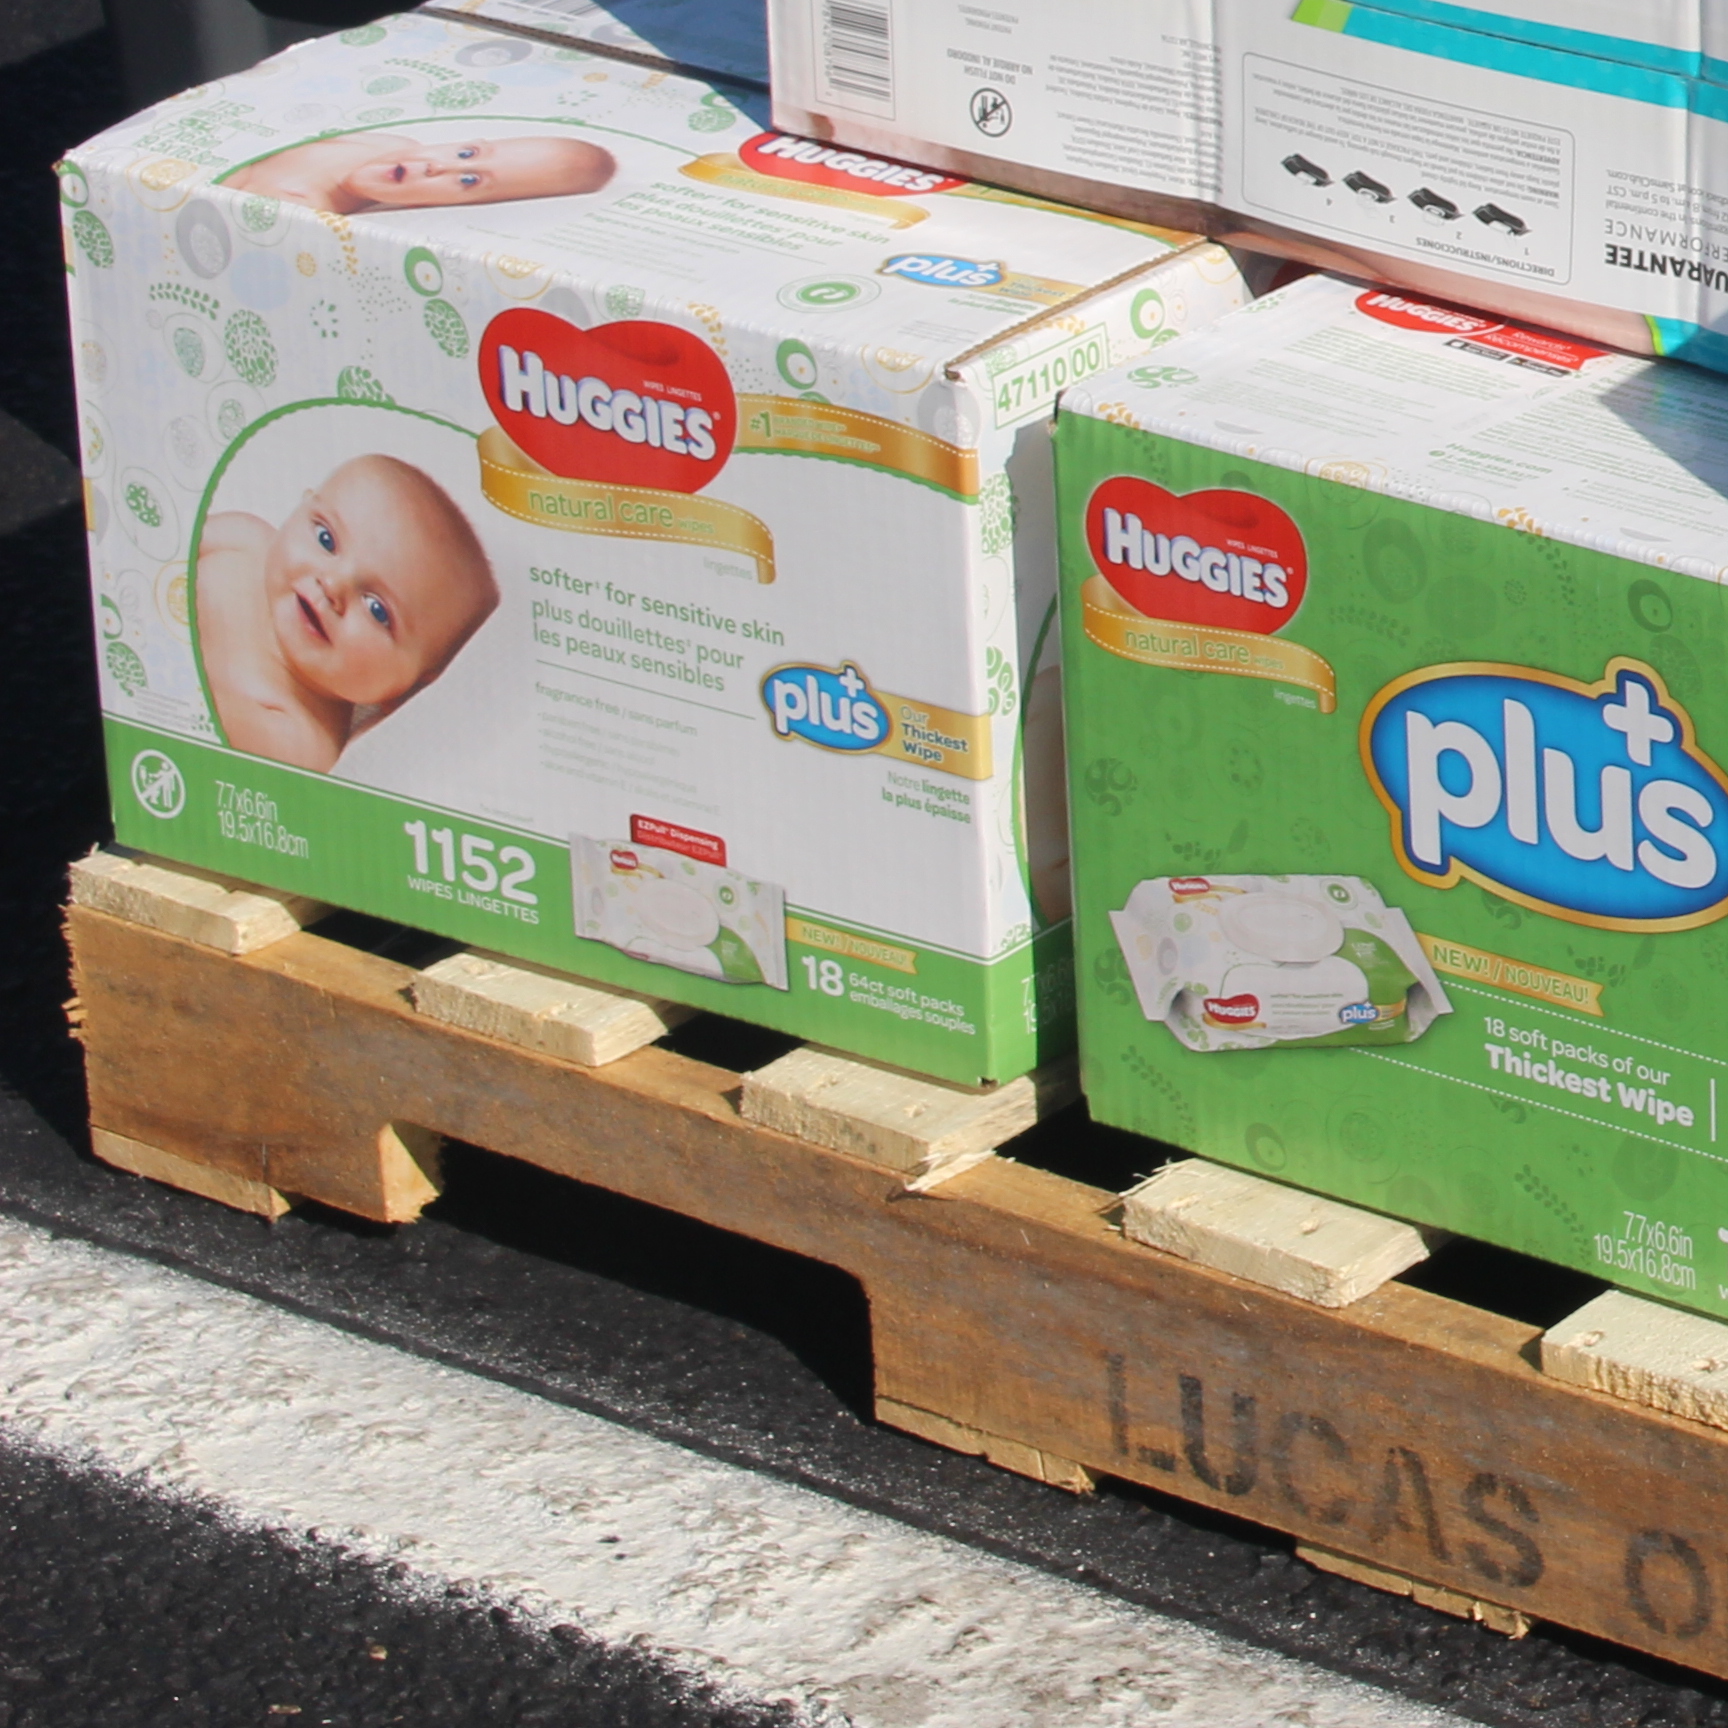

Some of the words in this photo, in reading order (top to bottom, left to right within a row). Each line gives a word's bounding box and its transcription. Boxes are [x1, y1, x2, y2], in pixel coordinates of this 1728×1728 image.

[497, 344, 717, 463] HUGGIES
[527, 487, 615, 523] natural
[619, 499, 674, 530] care
[1102, 508, 1292, 611] HUGGIES
[1124, 625, 1198, 660] natural
[1203, 637, 1249, 666] care
[769, 671, 881, 744] plus
[899, 723, 968, 753] Thickest
[1403, 697, 1719, 890] plus
[404, 817, 538, 906] 1152
[1483, 1042, 1612, 1105] Thickest
[1616, 1082, 1696, 1129] Wipe
[1104, 1350, 1546, 1588] LUCAS
